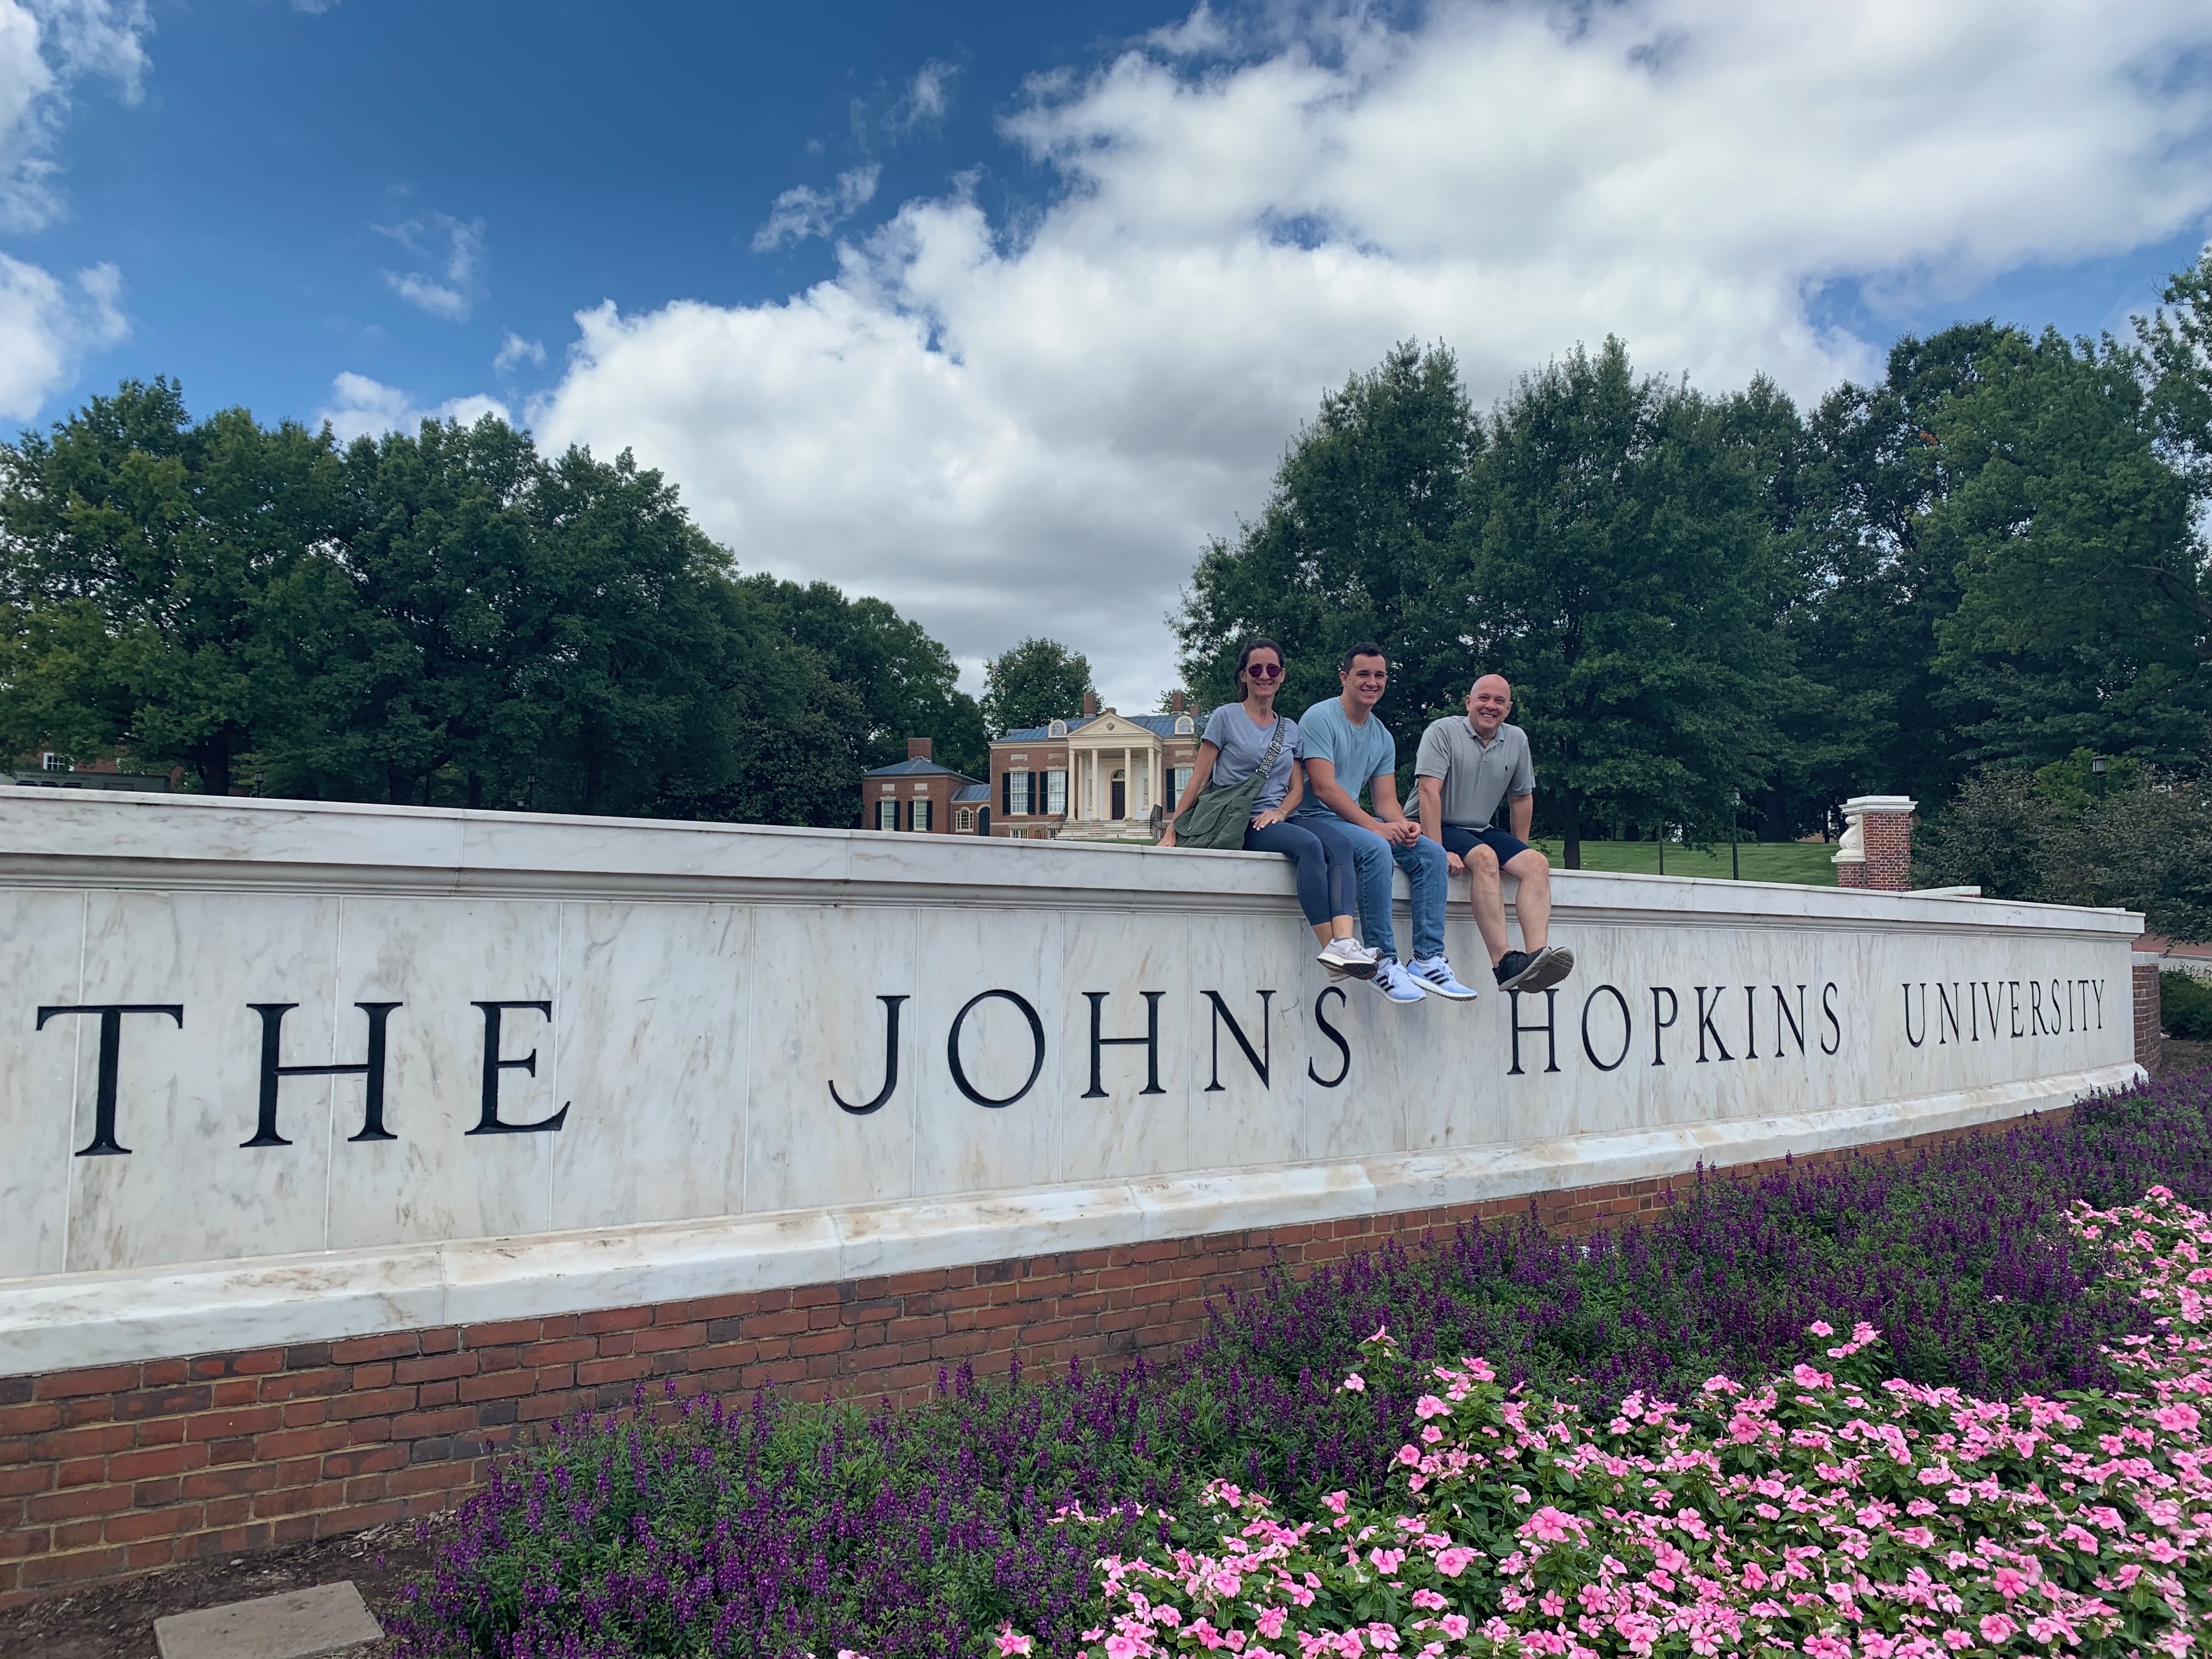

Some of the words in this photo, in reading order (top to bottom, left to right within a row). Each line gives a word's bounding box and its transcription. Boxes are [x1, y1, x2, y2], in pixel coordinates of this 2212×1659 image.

[36, 1001, 571, 1157] THE
[828, 986, 1351, 1116] JOHNS
[1506, 981, 1841, 1075] HOPKINS
[1901, 979, 2104, 1048] UNIVERSITY
